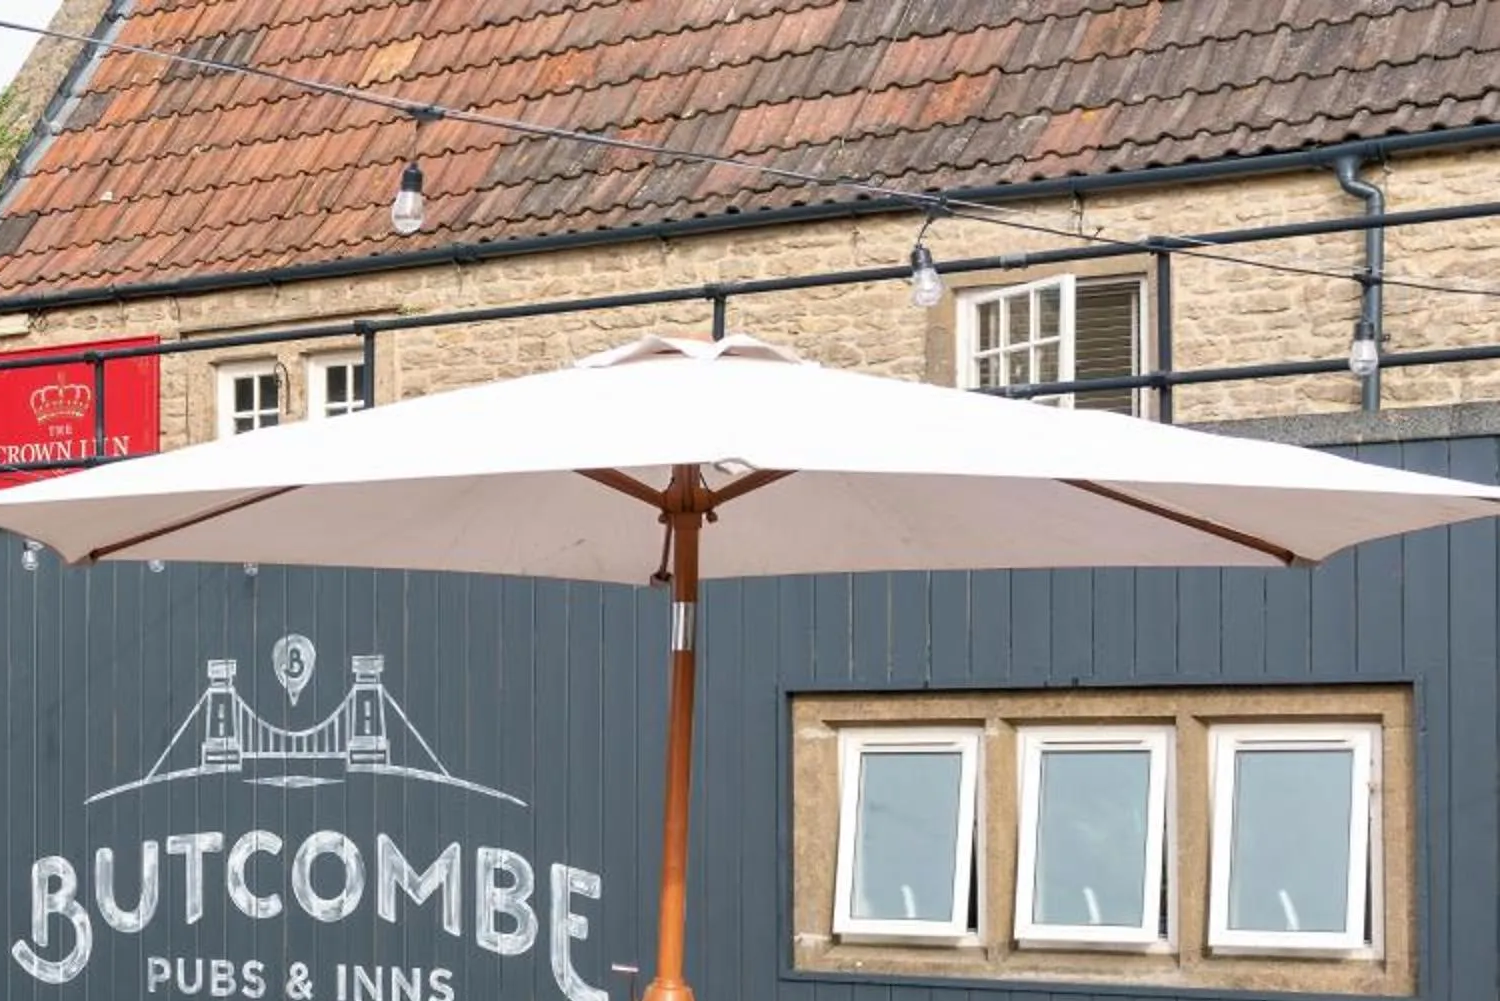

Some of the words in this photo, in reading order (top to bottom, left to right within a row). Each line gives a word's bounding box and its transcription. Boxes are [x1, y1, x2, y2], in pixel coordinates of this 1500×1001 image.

[47, 423, 72, 436] THE
[283, 647, 305, 679] B
[147, 956, 267, 1000] PUBS
[286, 961, 314, 1001] &
